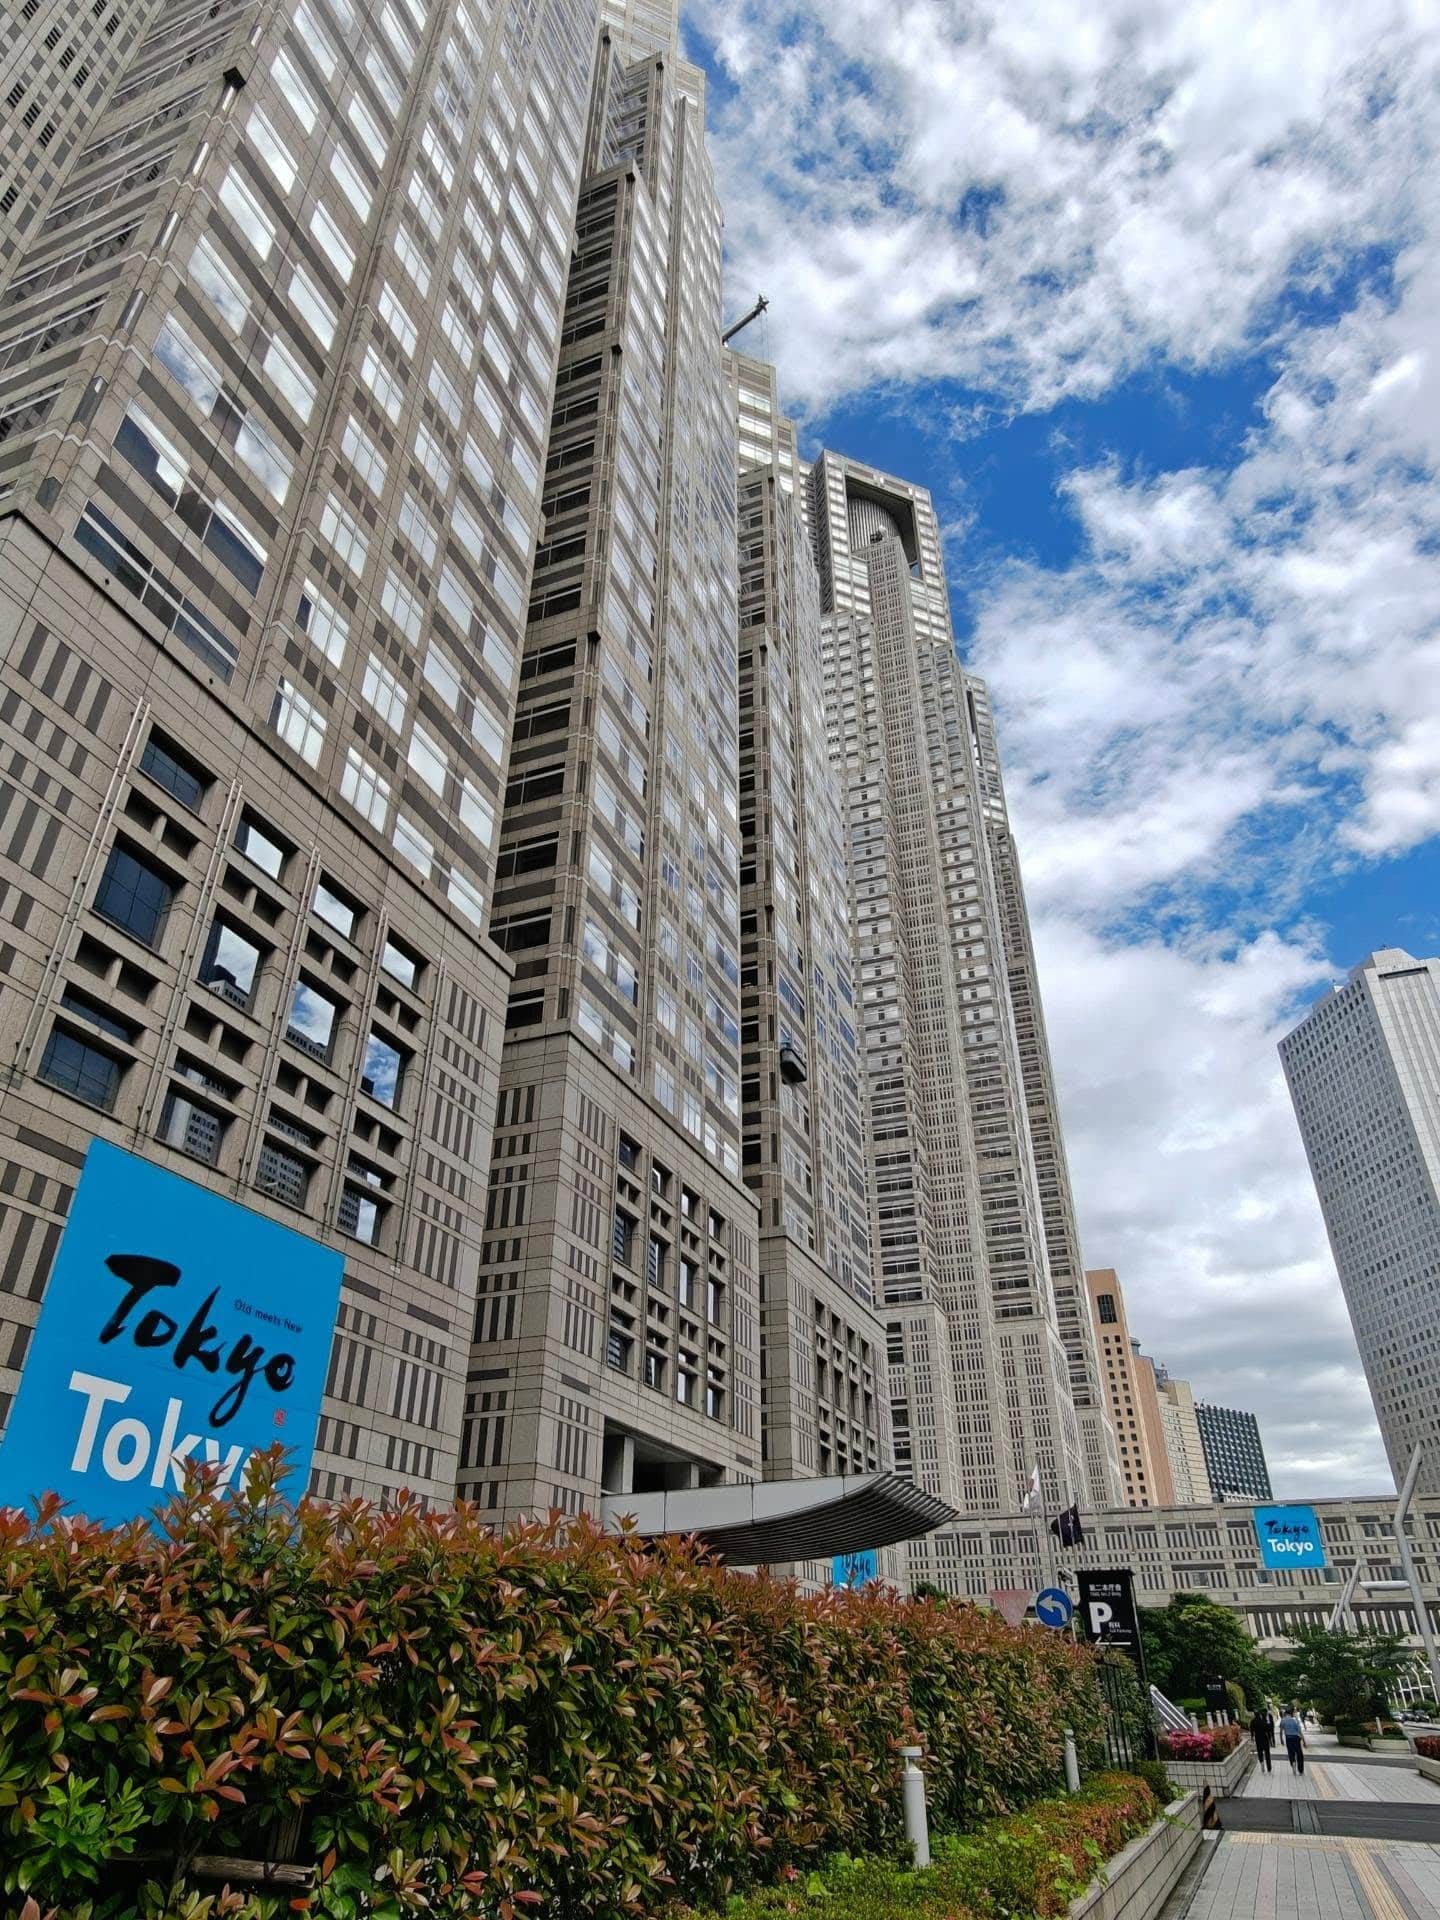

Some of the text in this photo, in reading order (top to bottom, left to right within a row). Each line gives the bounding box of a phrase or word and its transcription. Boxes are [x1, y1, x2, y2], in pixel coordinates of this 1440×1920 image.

[234, 1298, 252, 1316] Old
[255, 1309, 281, 1328] meets
[99, 1253, 297, 1428] Tokyo
[1264, 1520, 1309, 1541] Tokyo
[1267, 1538, 1314, 1556] Tokyo
[1088, 1602, 1113, 1633] P
